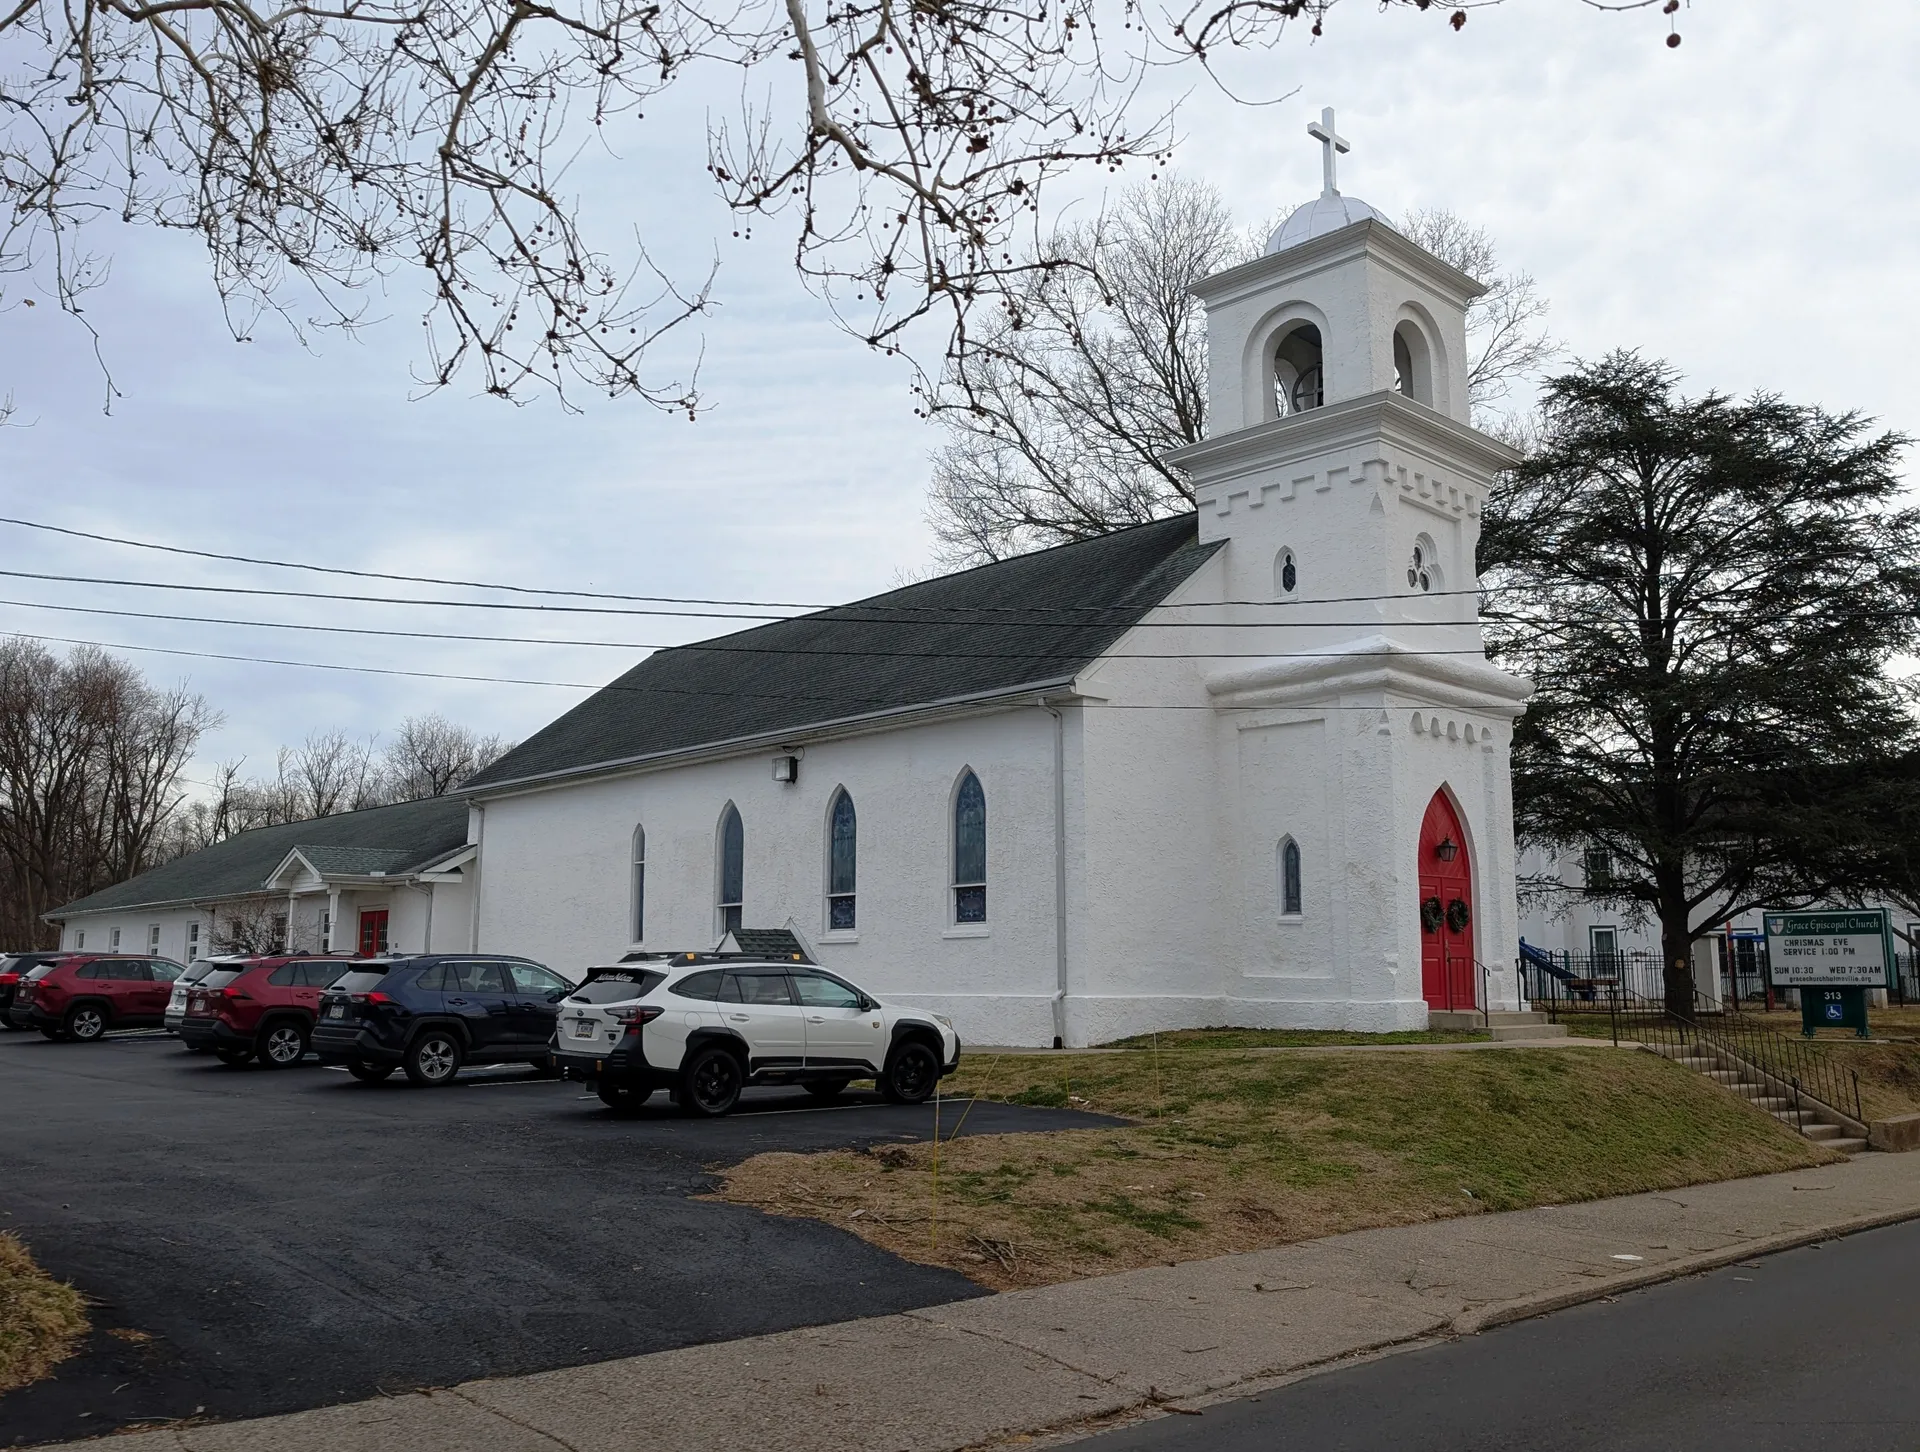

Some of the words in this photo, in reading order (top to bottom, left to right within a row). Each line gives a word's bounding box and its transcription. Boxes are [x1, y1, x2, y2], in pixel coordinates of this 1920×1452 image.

[1786, 919, 1809, 934] Grace
[1810, 918, 1847, 932] Episcopal
[1848, 917, 1879, 929] Church
[1784, 938, 1825, 947] CHRISMAS
[1833, 938, 1849, 946] EVE
[1783, 948, 1817, 956] SERVICE
[1821, 947, 1839, 955] 1:00
[1843, 947, 1856, 955] PM
[1774, 966, 1790, 974] SUN
[1792, 966, 1814, 974] 10:30
[1829, 966, 1846, 974] WED
[1824, 991, 1842, 1000] 313
